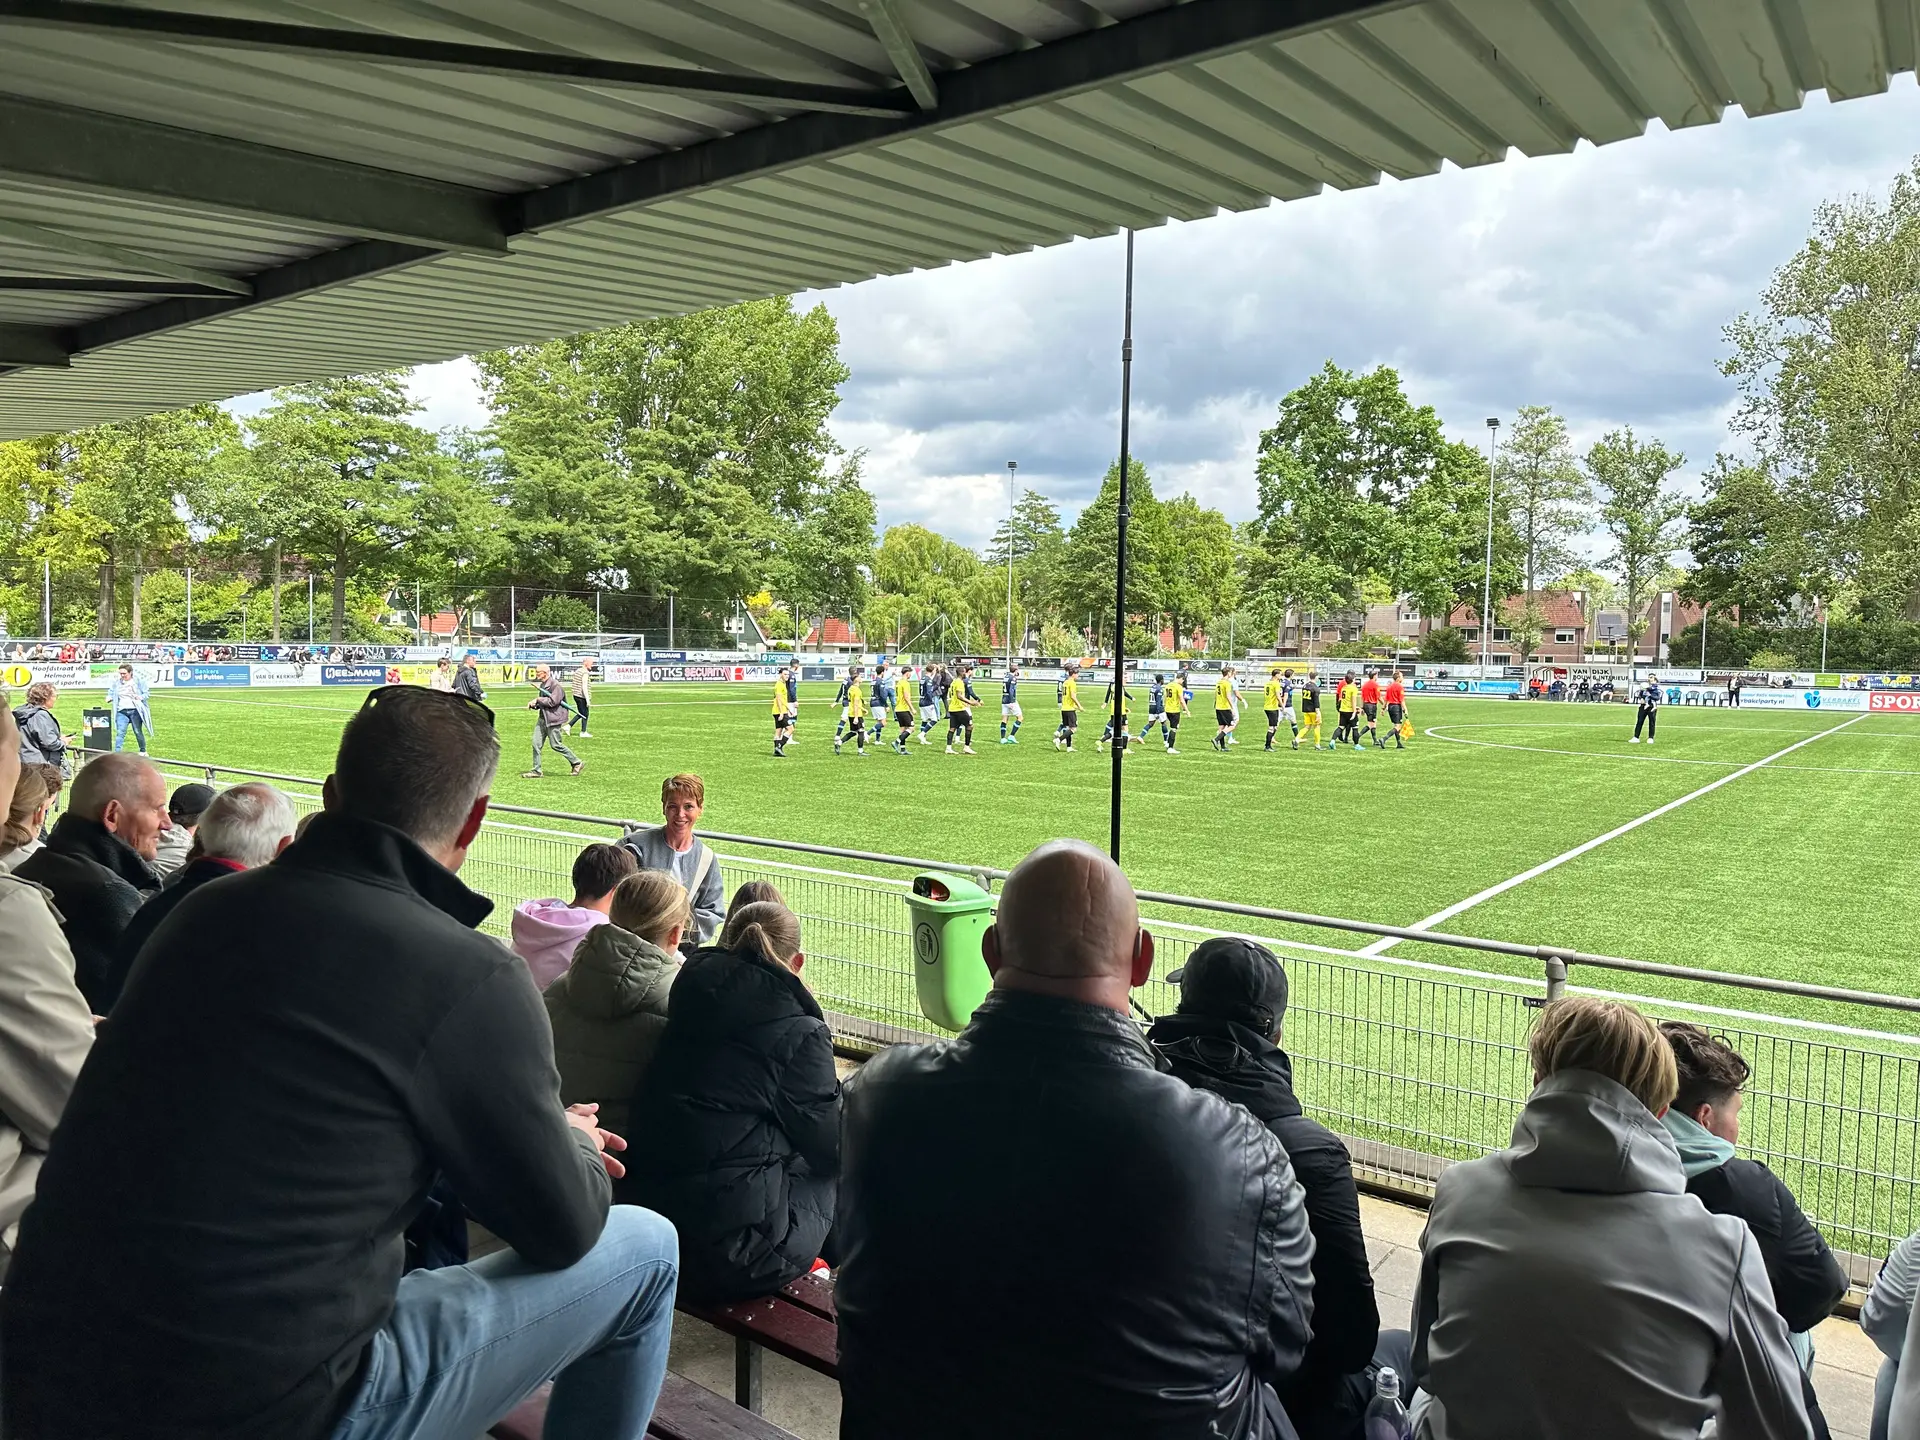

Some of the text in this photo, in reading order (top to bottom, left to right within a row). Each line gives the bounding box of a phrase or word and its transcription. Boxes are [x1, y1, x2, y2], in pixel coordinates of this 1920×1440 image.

[32, 665, 74, 673] Hoofdstraat
[662, 667, 725, 678] TKS SECURITY
